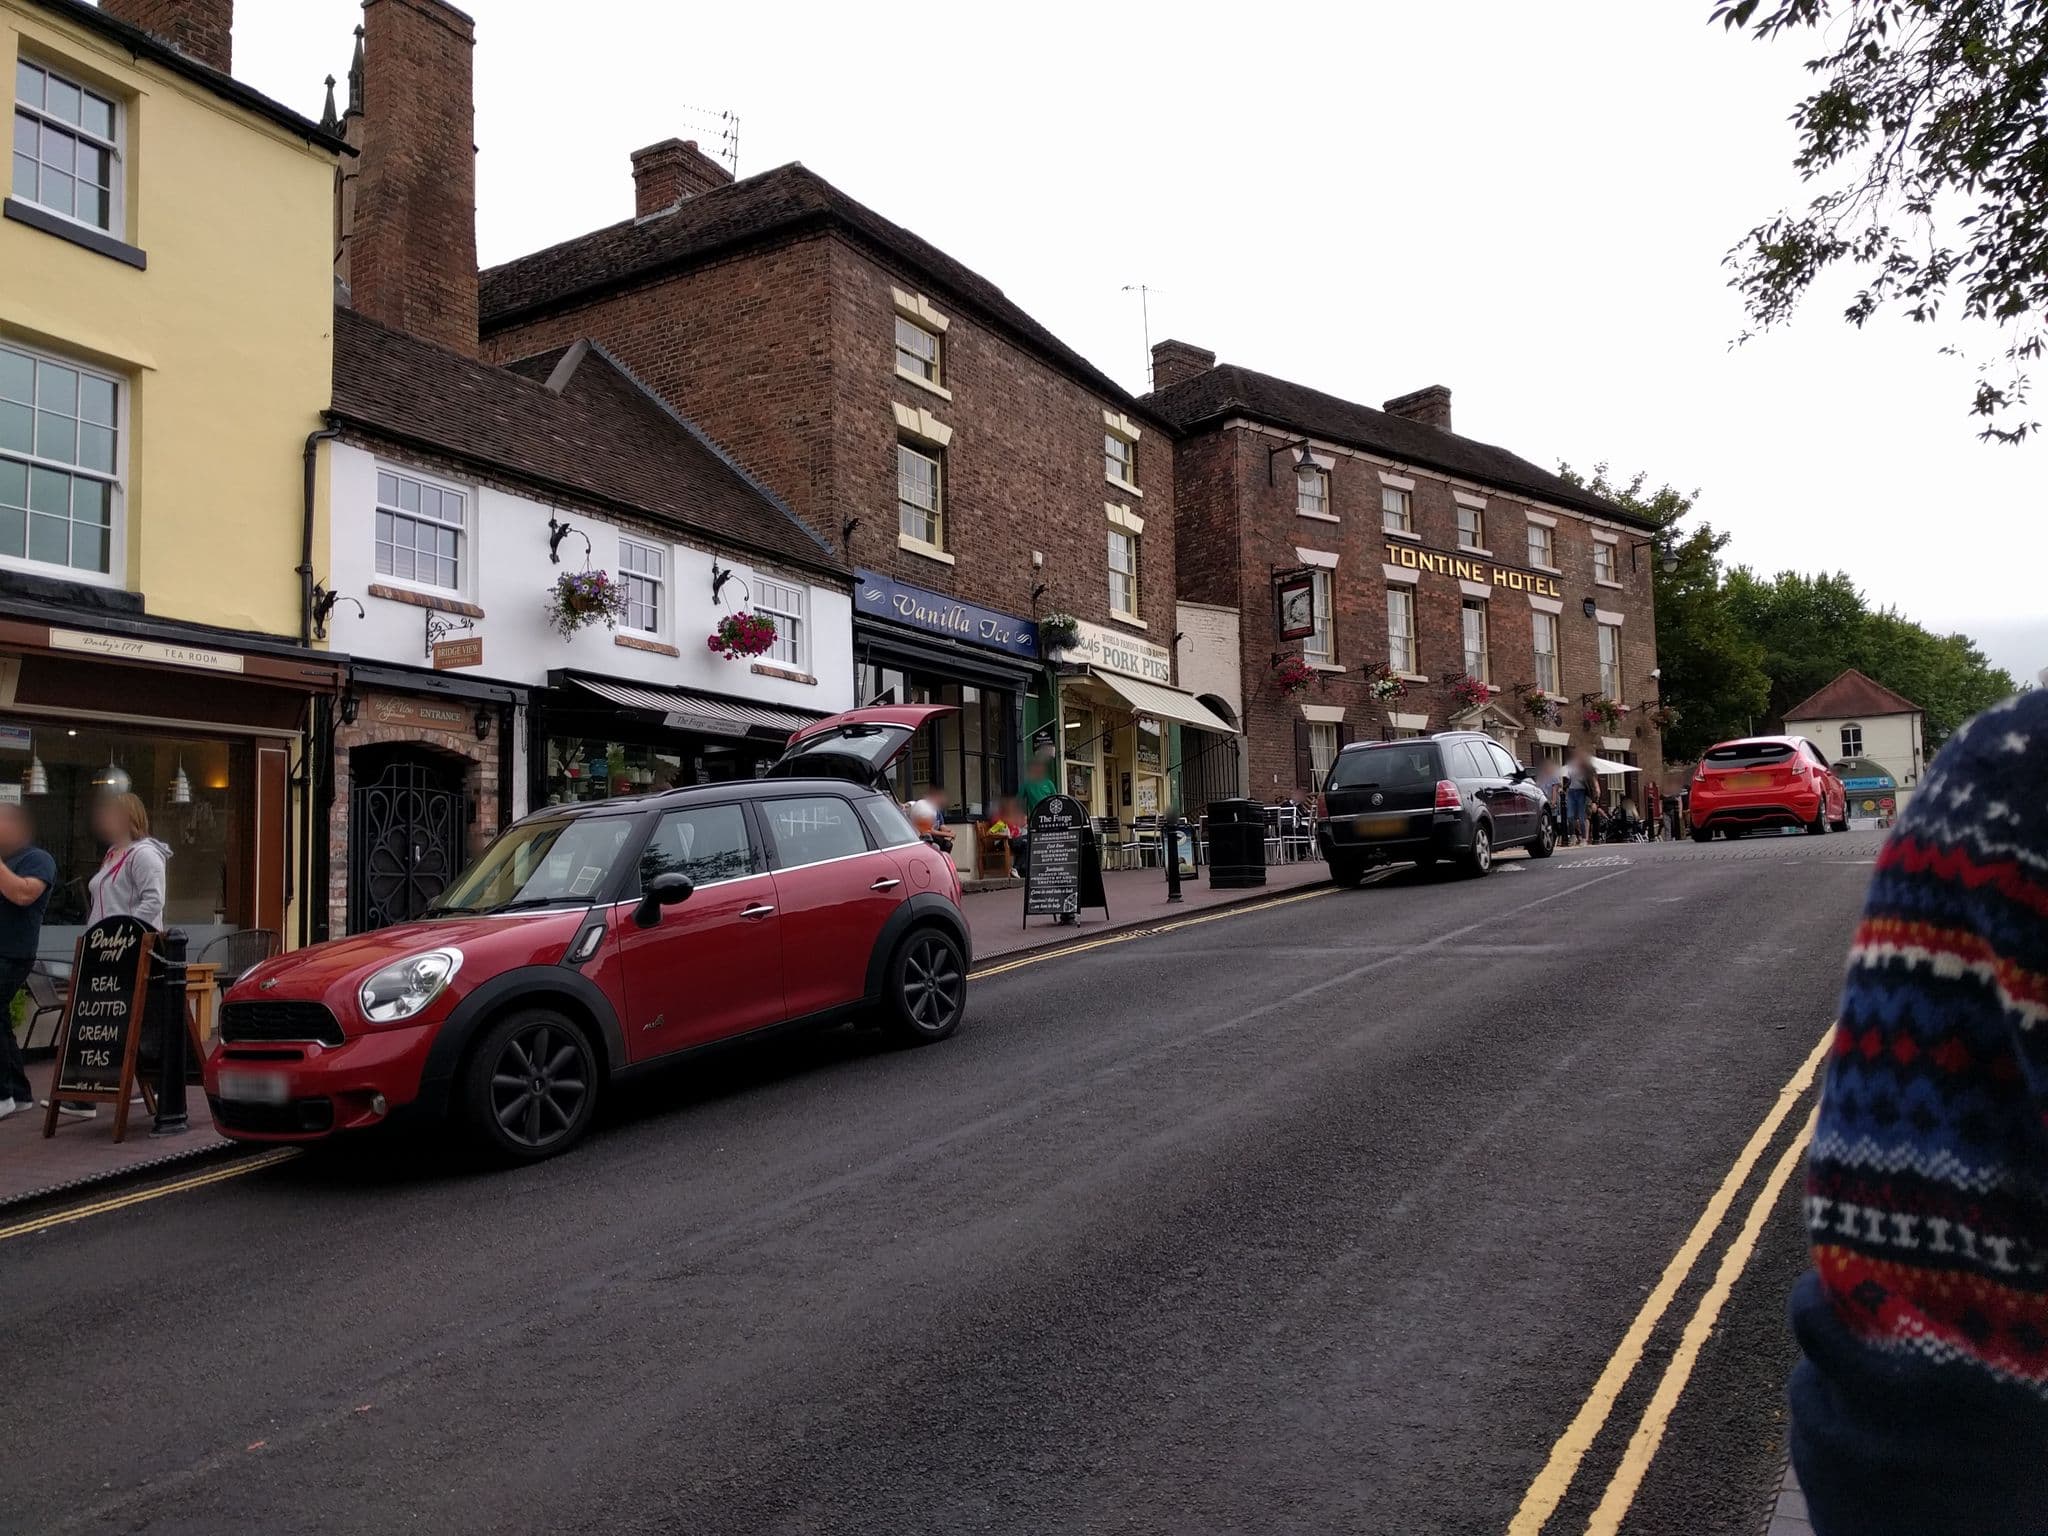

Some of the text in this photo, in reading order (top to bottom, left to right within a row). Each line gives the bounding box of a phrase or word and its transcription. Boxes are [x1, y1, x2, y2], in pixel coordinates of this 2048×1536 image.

[1385, 544, 1561, 597] TONTINE HOTEL
[893, 594, 1010, 644] Vanilla Ice
[164, 648, 218, 665] TEA ROOM
[437, 644, 479, 657] BRIDGE VIEW
[1102, 645, 1169, 682] PORK PIES
[420, 708, 461, 721] ENTRANCE
[677, 716, 688, 725] The
[1039, 814, 1073, 824] The Forge
[91, 924, 136, 962] Darby's
[91, 976, 121, 992] REAL
[78, 1001, 127, 1017] CLOTTED
[78, 1025, 119, 1041] CREAM
[80, 1050, 110, 1066] TEAS
